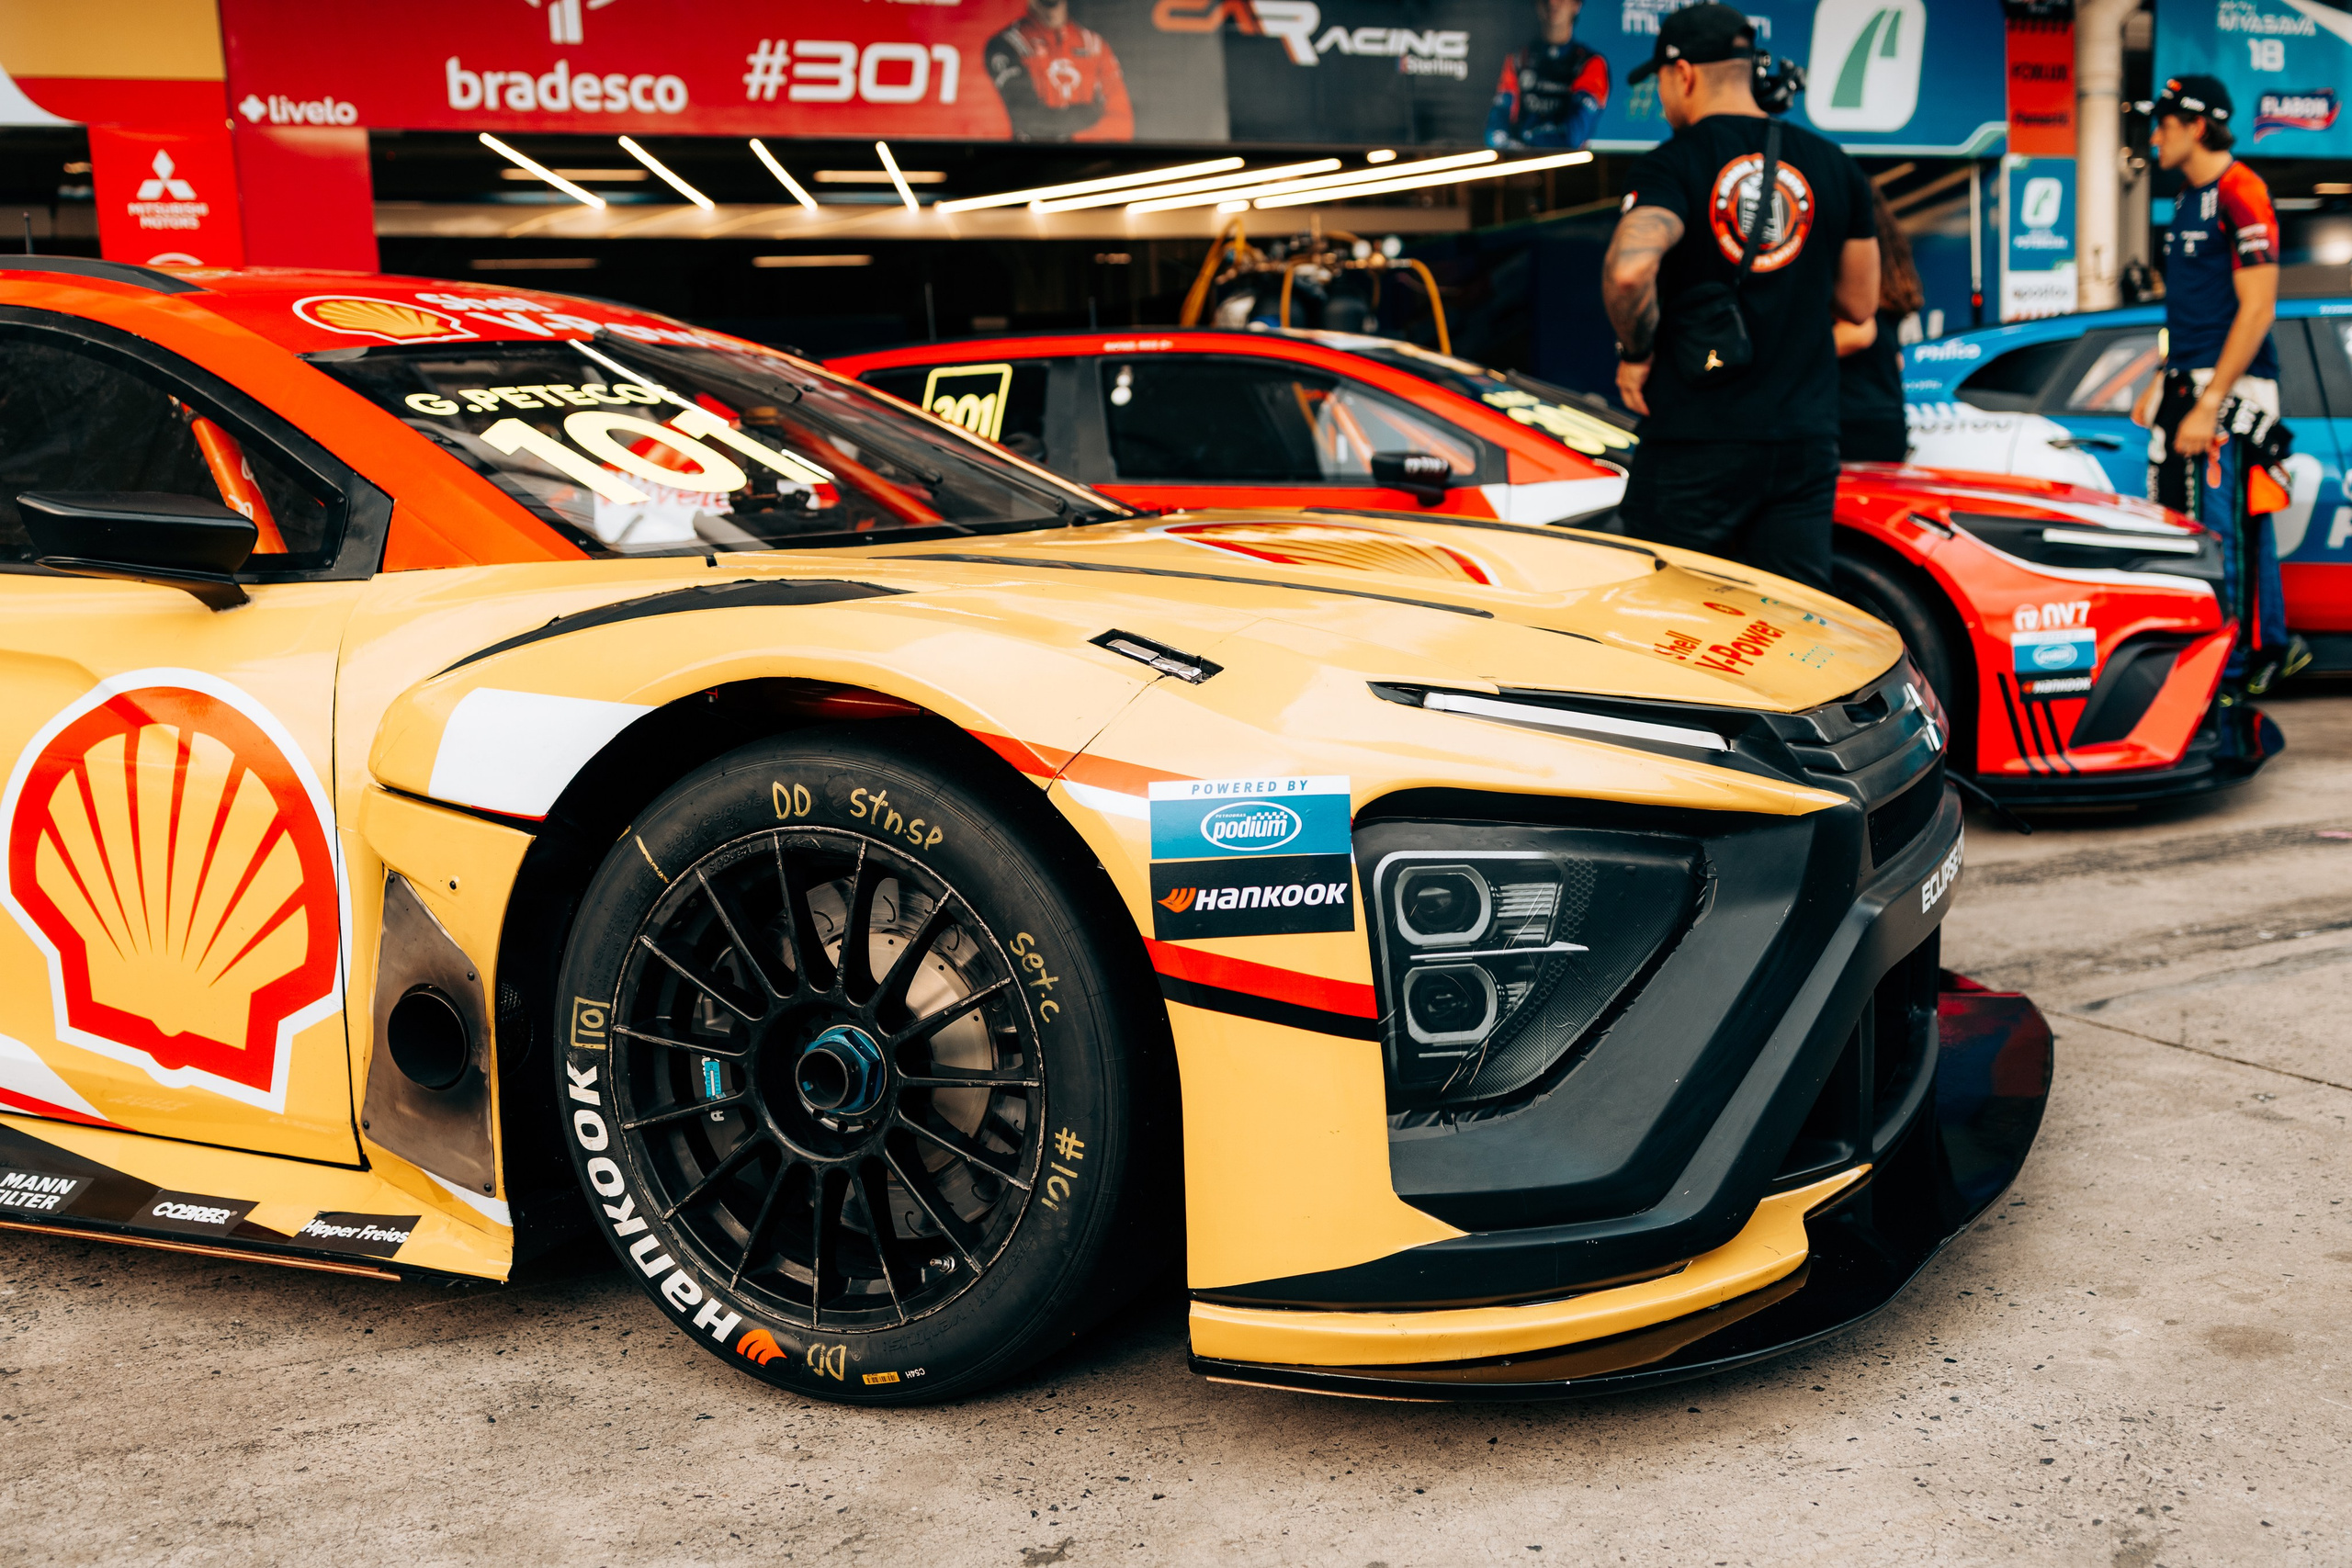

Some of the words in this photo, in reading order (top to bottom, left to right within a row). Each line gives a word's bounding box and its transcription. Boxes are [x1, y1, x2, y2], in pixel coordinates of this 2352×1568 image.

[2247, 38, 2286, 73] 18
[446, 55, 688, 114] bradesco
[742, 39, 961, 105] #301
[268, 95, 358, 126] livelo
[127, 202, 209, 217] MITSUBISHI
[140, 216, 201, 230] MOTORS
[479, 410, 830, 506] 101
[1653, 629, 1702, 660] Shell
[1192, 781, 1277, 795] POWERED
[1287, 780, 1308, 792] BY
[1213, 816, 1288, 842] podium
[1922, 845, 1959, 915] ECLIPSE
[0, 1172, 77, 1195] MANN
[300, 1219, 361, 1239] Hipper
[356, 1224, 411, 1244] Freios
[904, 1368, 926, 1379] C54H
